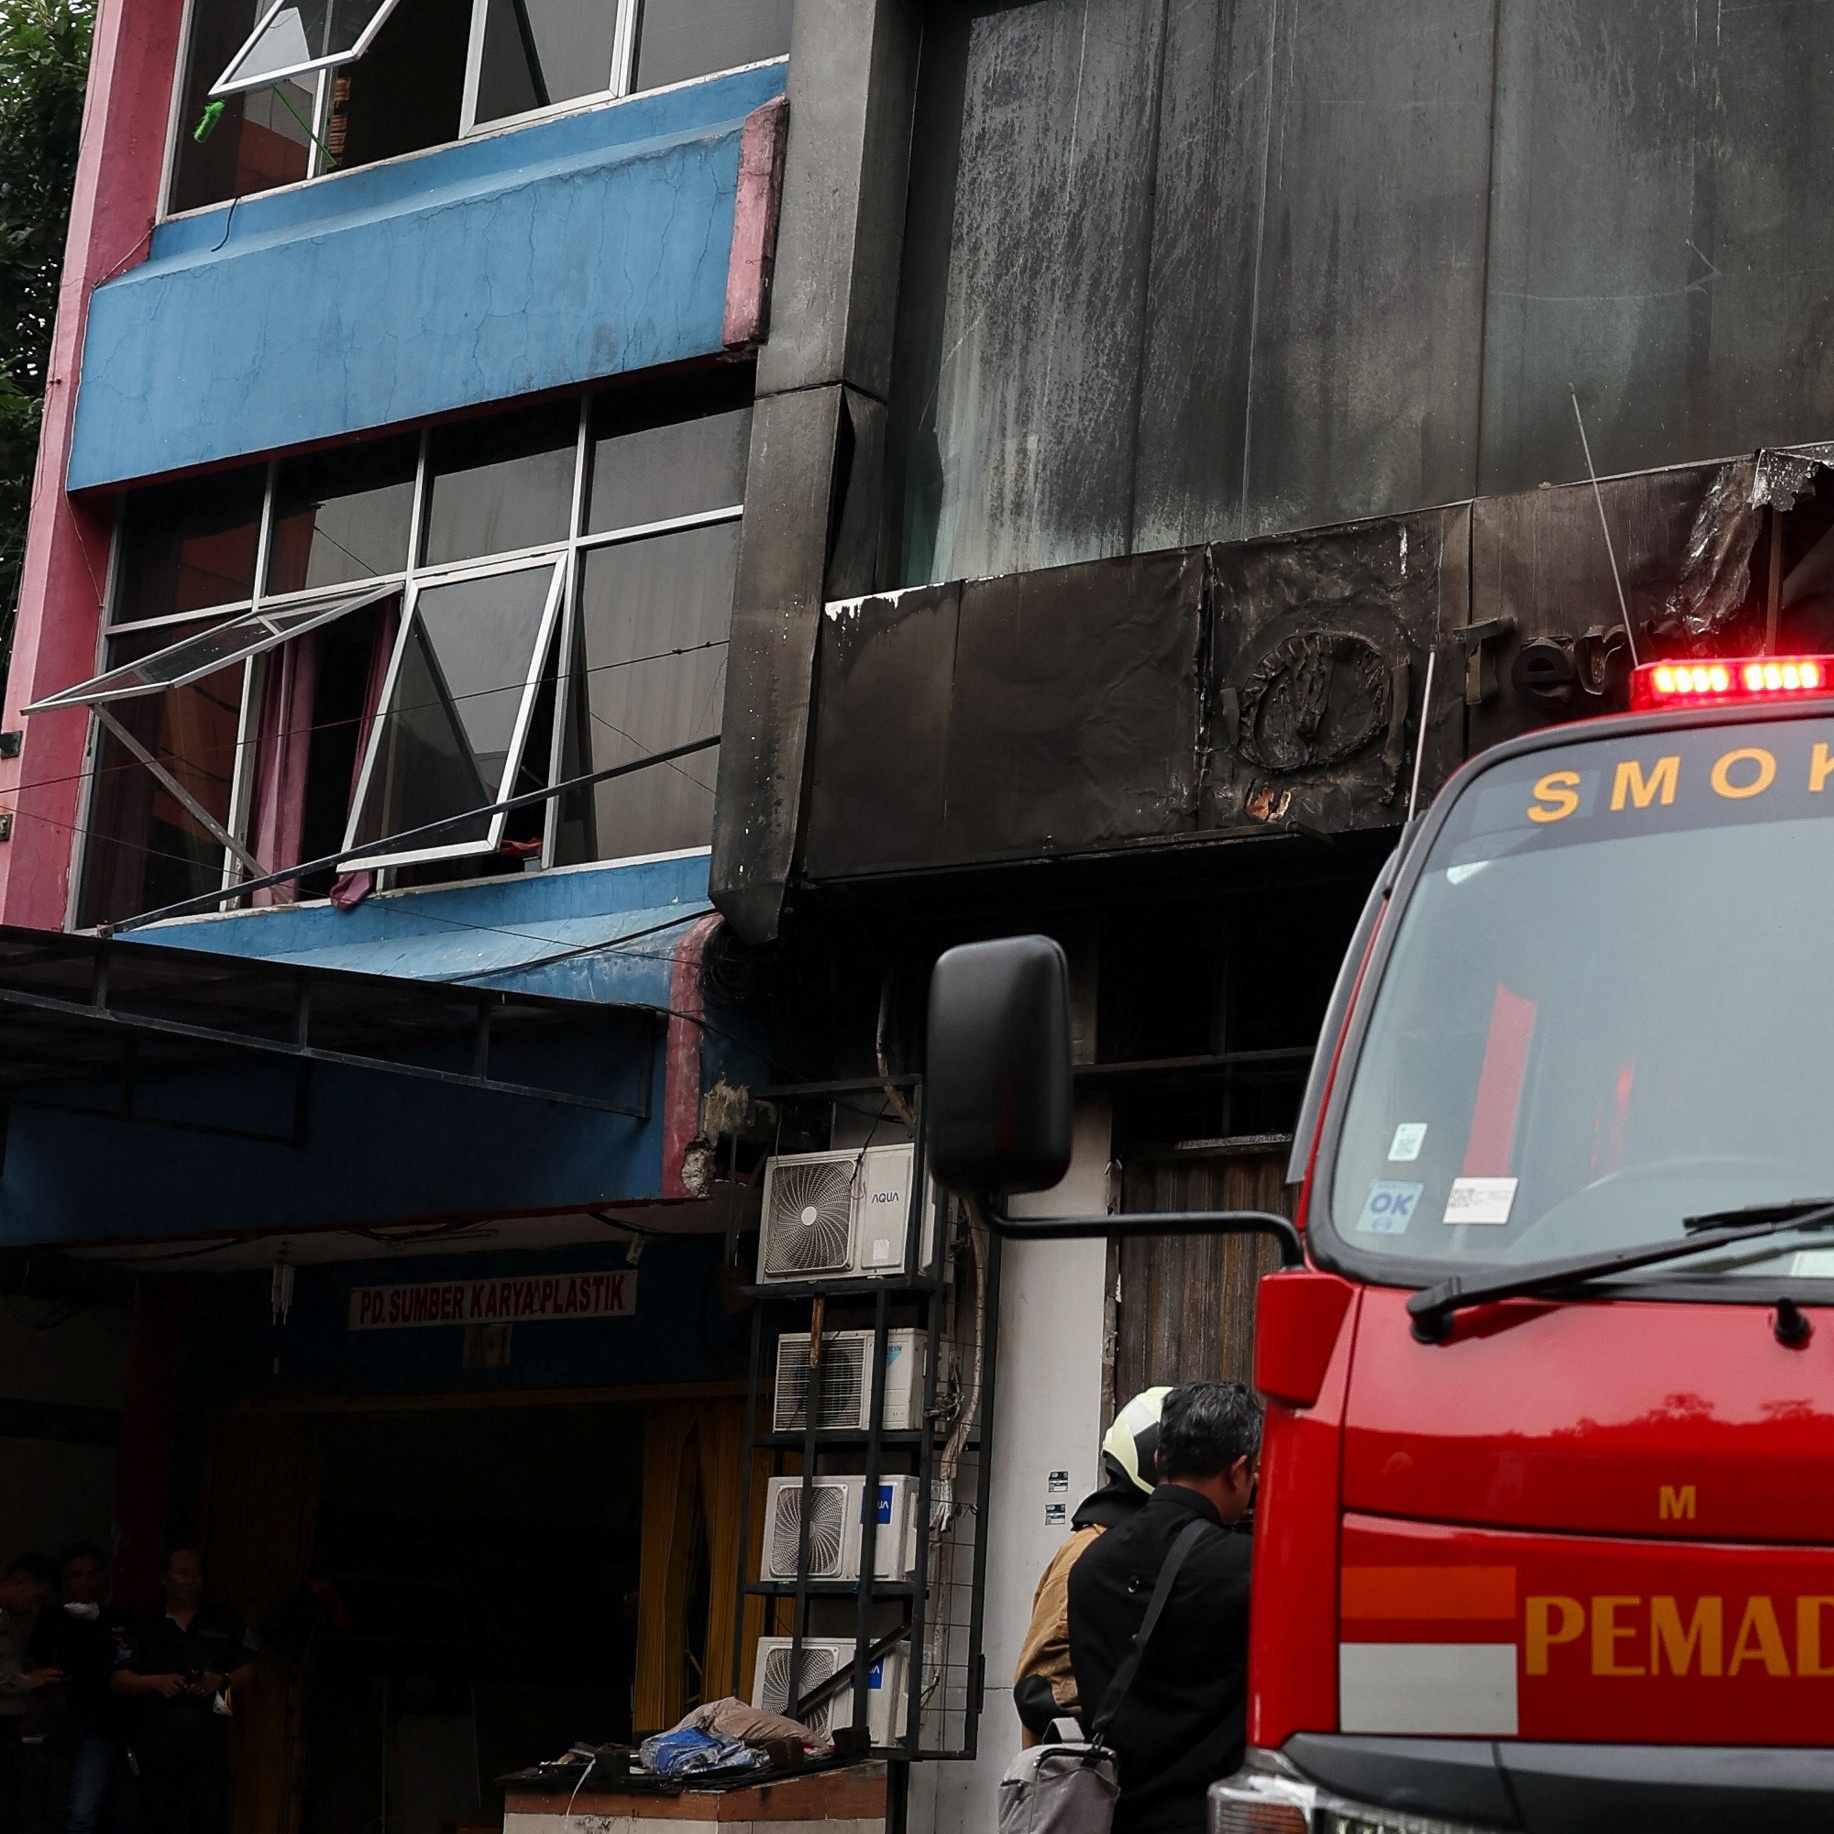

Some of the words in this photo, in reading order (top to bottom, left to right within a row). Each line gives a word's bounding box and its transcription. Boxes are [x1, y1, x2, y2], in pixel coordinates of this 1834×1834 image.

[871, 1192, 900, 1204] AQUA
[1369, 1192, 1414, 1216] OK
[360, 1290, 386, 1325] PD.
[389, 1285, 465, 1324] SUMBER
[470, 1281, 535, 1318] KARYA
[540, 1274, 625, 1315] PLASTIK
